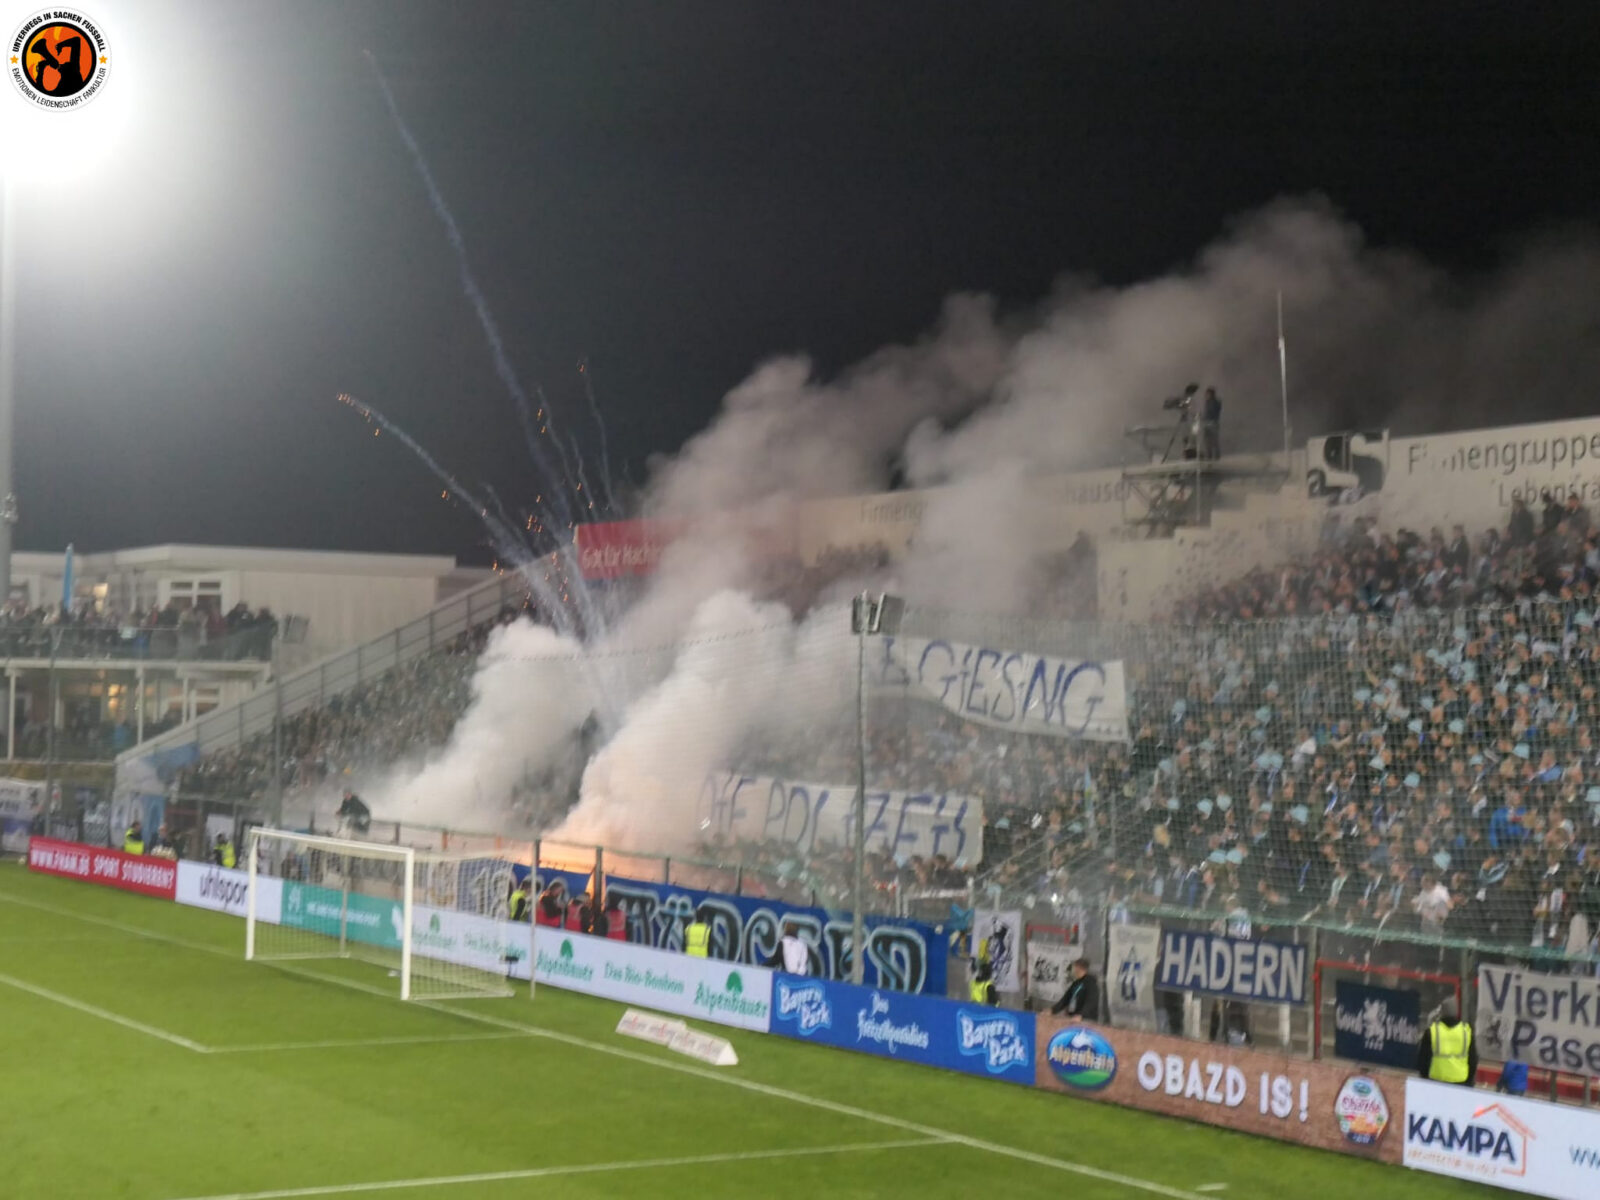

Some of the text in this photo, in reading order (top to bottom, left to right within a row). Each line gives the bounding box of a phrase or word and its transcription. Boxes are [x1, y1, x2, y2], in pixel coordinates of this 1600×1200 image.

[200, 865, 248, 910] uhlspor
[1161, 933, 1306, 1001] HADERN
[780, 985, 822, 1014] Bayern
[801, 1000, 830, 1029] Park
[960, 1016, 1014, 1048] Bayern
[988, 1035, 1025, 1066] Park
[1048, 1043, 1115, 1072] Alpenhain
[1137, 1050, 1310, 1123] OBAZD IS!
[1408, 1113, 1516, 1163] KAMPA
